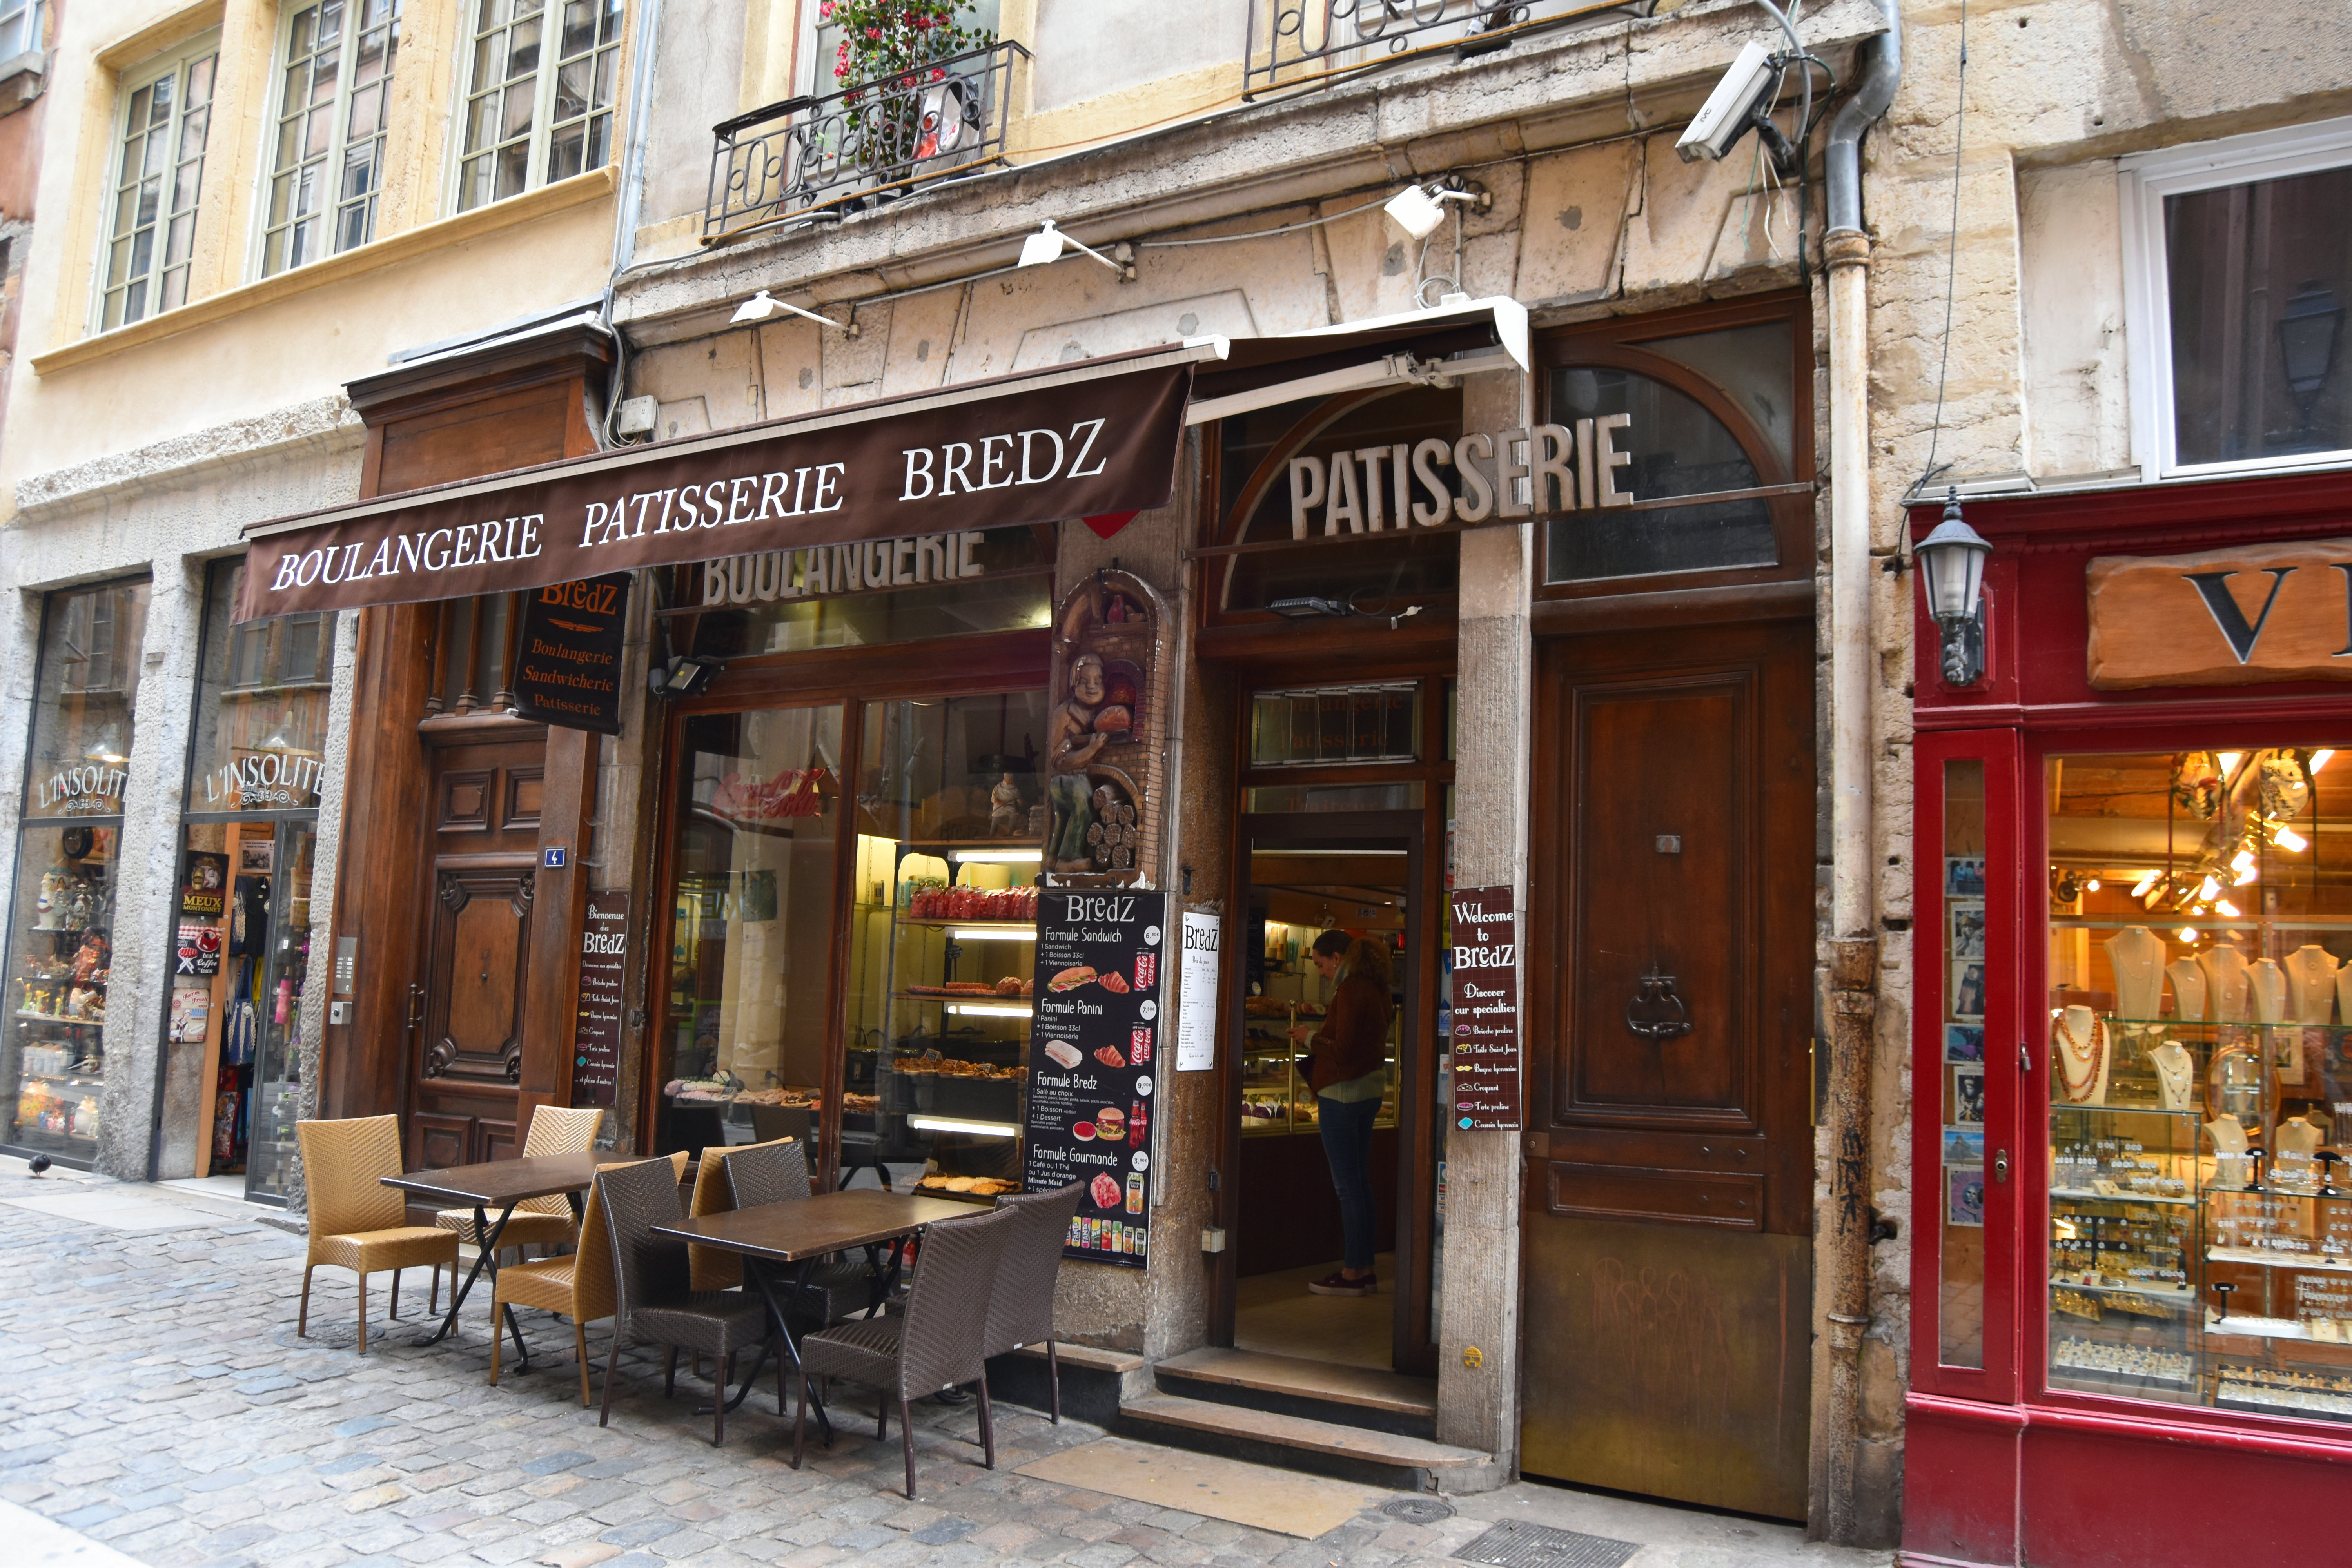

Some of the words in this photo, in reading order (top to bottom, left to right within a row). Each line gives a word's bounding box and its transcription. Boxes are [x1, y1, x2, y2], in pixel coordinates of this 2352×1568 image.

[1290, 413, 1634, 540] PATISSERIE
[271, 514, 543, 591] BOULANGERIE
[579, 462, 844, 548] PATISSERIE
[899, 418, 1107, 501] BREDZ
[703, 532, 984, 606] BOULANGERIE
[539, 581, 618, 615] BredZ
[532, 639, 613, 664] Boulangerie
[523, 665, 614, 691] Sandwicherie
[534, 693, 601, 715] Patisserie
[551, 851, 557, 864] 4
[587, 903, 624, 920] Bienvenue
[1065, 895, 1135, 922] BredZ
[1452, 902, 1514, 924] Welcome
[600, 922, 609, 931] chez
[1045, 926, 1078, 942] Formule
[1082, 927, 1122, 942] Sandwich
[1477, 927, 1489, 942] to
[582, 932, 625, 954] BredZ
[1184, 925, 1218, 952] BredZ
[197, 958, 217, 968] Coffee
[1453, 944, 1515, 969] BredZ
[183, 991, 200, 1000] Farm
[1464, 982, 1505, 998] Discover
[1041, 998, 1074, 1014] Formule
[1077, 1000, 1102, 1016] Panini
[1473, 999, 1516, 1019] specialties
[1045, 1031, 1079, 1040] Viennoiserie
[1472, 1025, 1494, 1035] Brioche
[1495, 1025, 1514, 1037] praline
[1473, 1044, 1488, 1053] Tuile
[1489, 1044, 1504, 1053] Saint
[1503, 1044, 1517, 1055] Jean
[1474, 1063, 1492, 1075] Bugne
[1493, 1063, 1517, 1075] lyonnaise
[1037, 1071, 1070, 1088] Formule
[1073, 1074, 1097, 1090] Bredz
[1474, 1082, 1499, 1094] Croquant
[1474, 1101, 1490, 1110] Tarte
[1491, 1101, 1509, 1113] praline
[1474, 1119, 1496, 1129] Coussin
[1497, 1119, 1519, 1131] lyonnais
[1033, 1144, 1067, 1161] Formule
[1069, 1147, 1118, 1167] Gourmande
[1028, 1176, 1047, 1185] Minute
[1051, 1171, 1076, 1180] d'orange
